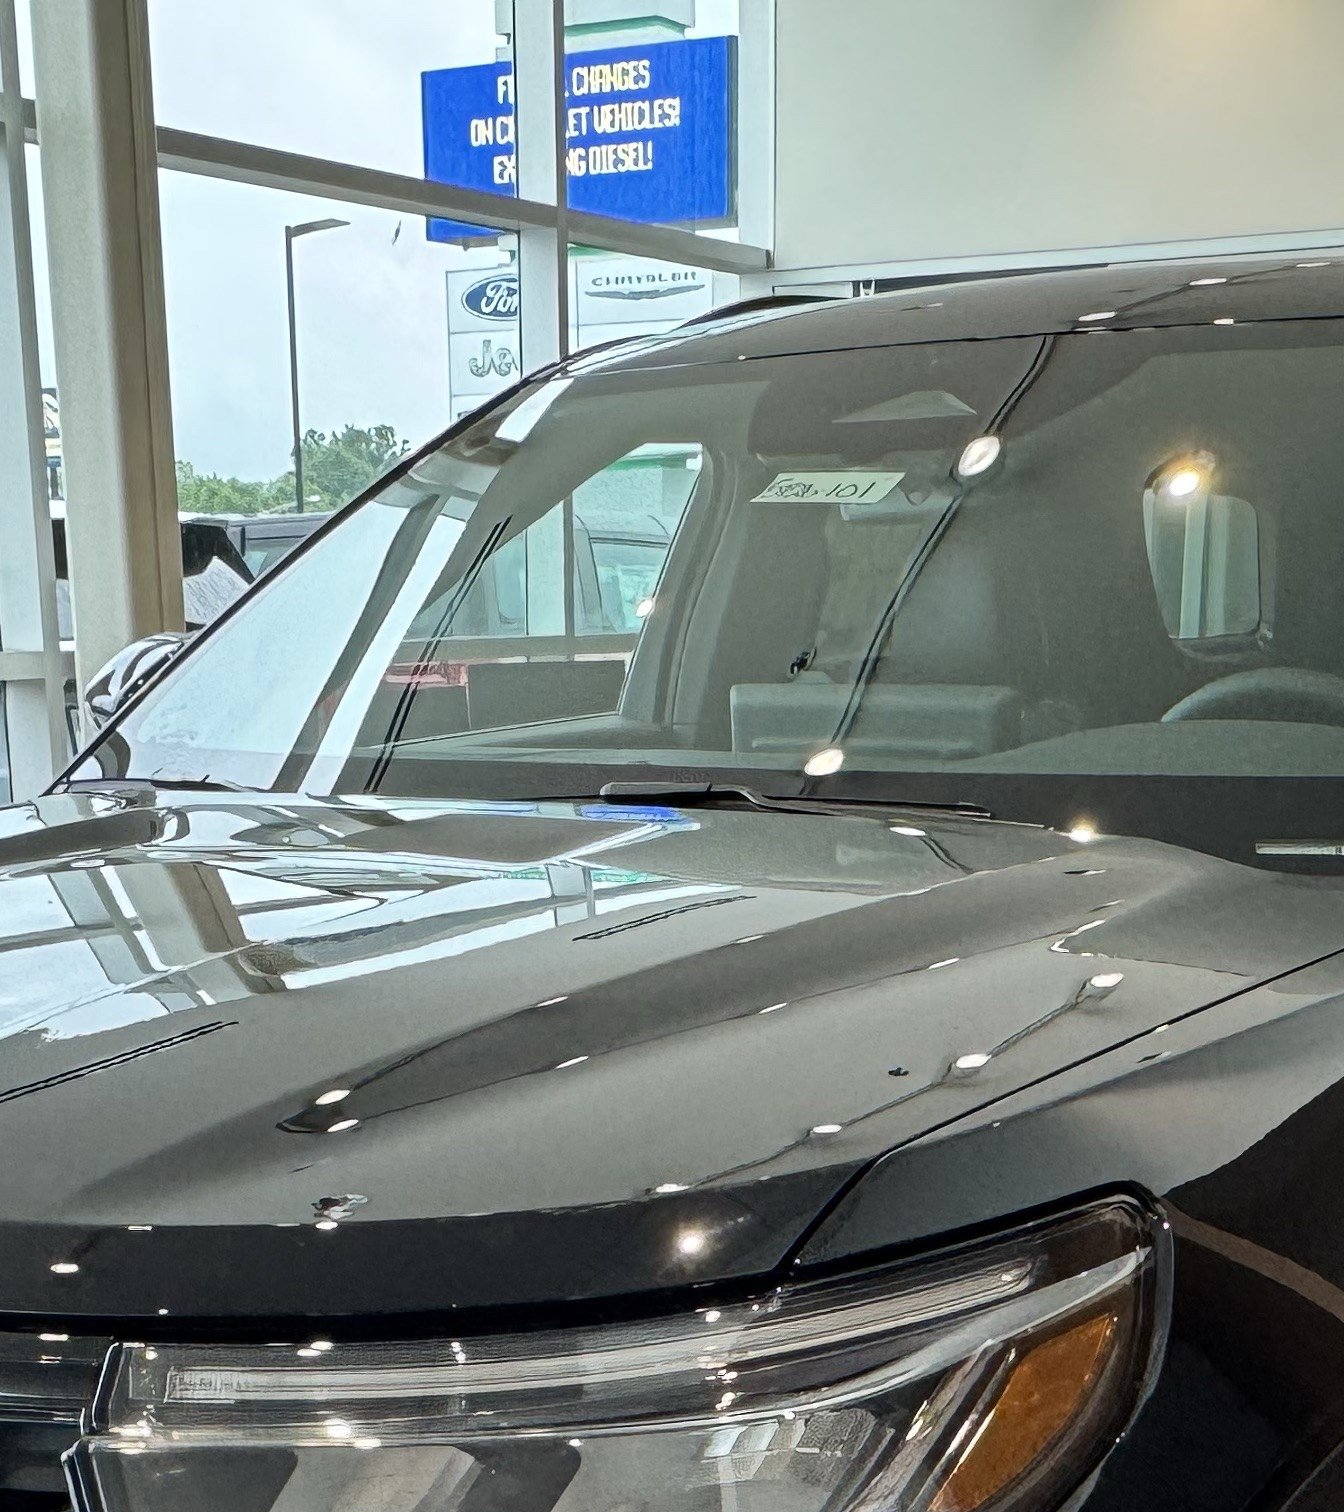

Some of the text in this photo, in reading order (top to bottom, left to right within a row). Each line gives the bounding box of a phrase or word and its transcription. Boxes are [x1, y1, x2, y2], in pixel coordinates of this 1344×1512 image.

[571, 59, 651, 96] CHANGES
[470, 117, 493, 147] ON
[593, 96, 681, 135] VEHICLES!
[588, 140, 653, 176] DIESEL!
